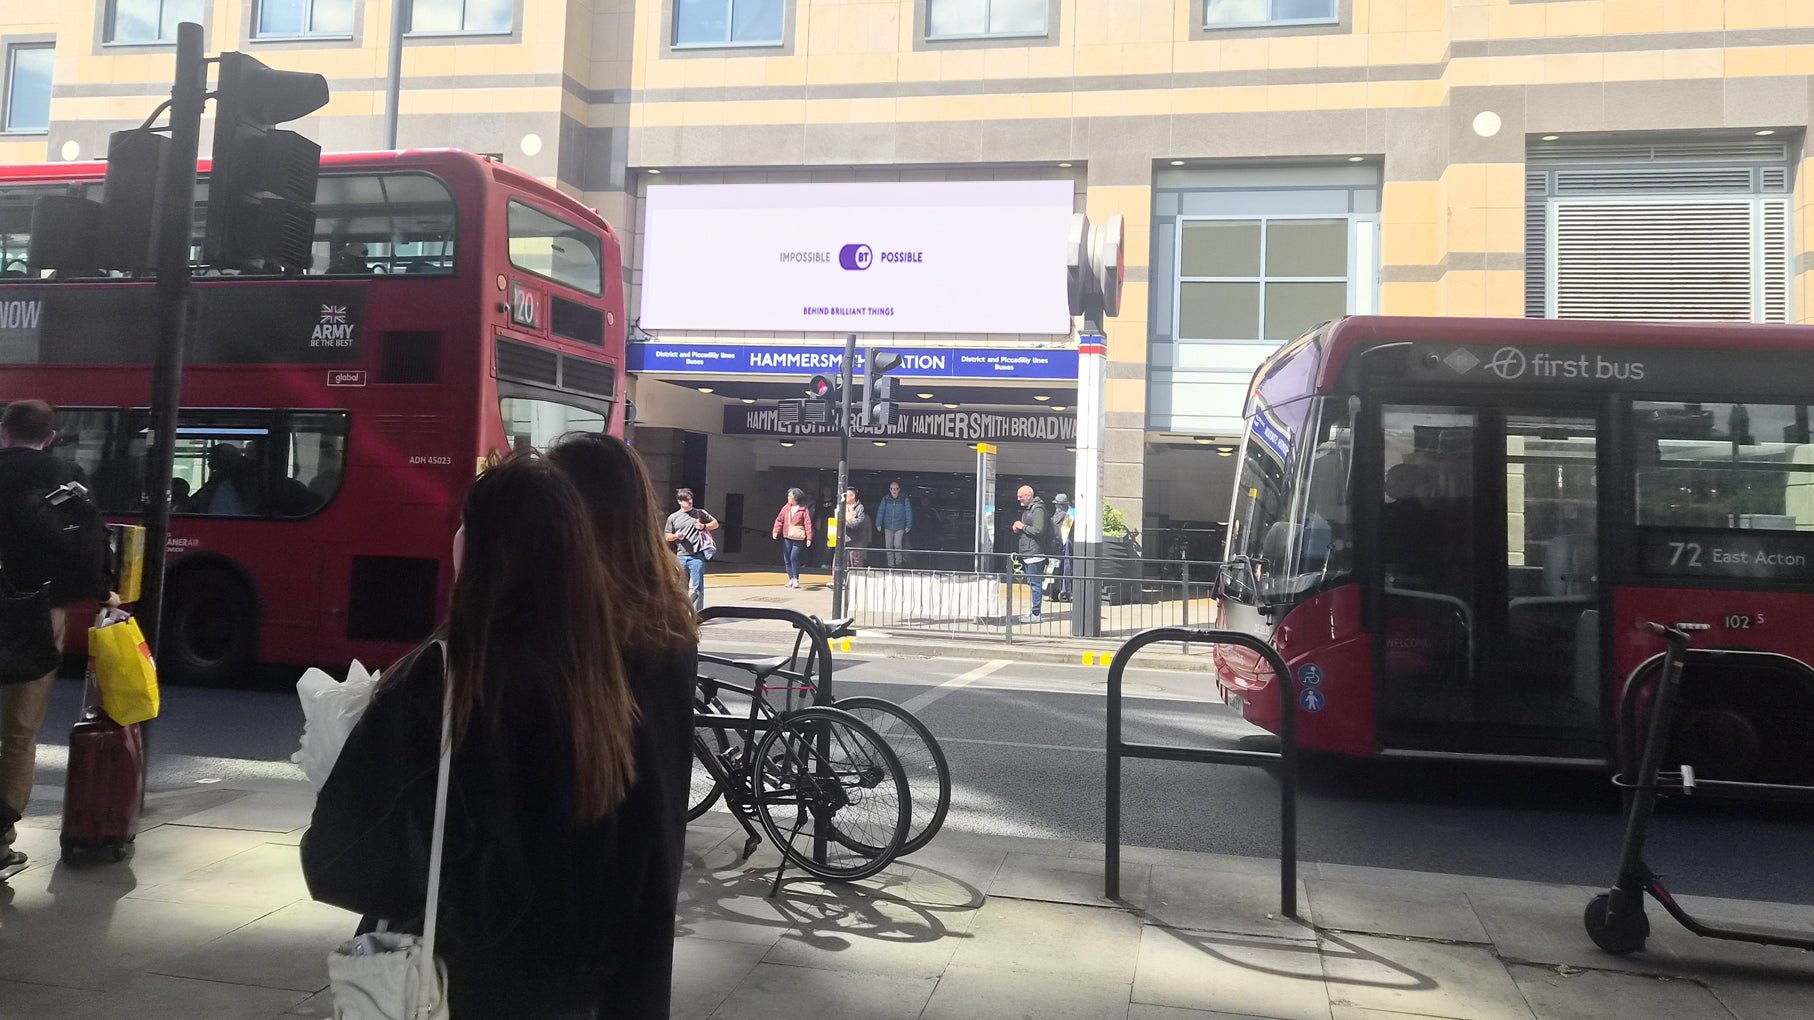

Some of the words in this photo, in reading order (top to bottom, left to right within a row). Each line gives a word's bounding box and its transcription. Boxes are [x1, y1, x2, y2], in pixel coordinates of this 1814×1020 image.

[779, 252, 831, 263] IMPOSSIBLE
[858, 252, 870, 263] BT
[881, 252, 923, 263] POSSIBLE
[803, 307, 829, 316] BEHIND
[831, 307, 866, 316] BRILLIANT
[868, 307, 894, 316] THINGS
[312, 324, 354, 339] ARMY
[310, 339, 319, 347] BE
[321, 339, 334, 347] THE
[335, 339, 353, 347] BEST
[692, 351, 720, 360] Piccadilly
[1001, 356, 1031, 365] Piccadilly
[1532, 353, 1589, 378] first
[1595, 355, 1645, 380] bus
[335, 373, 359, 384] global
[912, 412, 1009, 439] HAMMERSMITH
[1011, 416, 1077, 440] BROADWA
[409, 456, 427, 464] ADH
[428, 456, 451, 465] 45023
[1669, 542, 1702, 567] 72
[1712, 549, 1749, 563] East
[1754, 550, 1806, 566] Acton
[1725, 615, 1750, 629] 102
